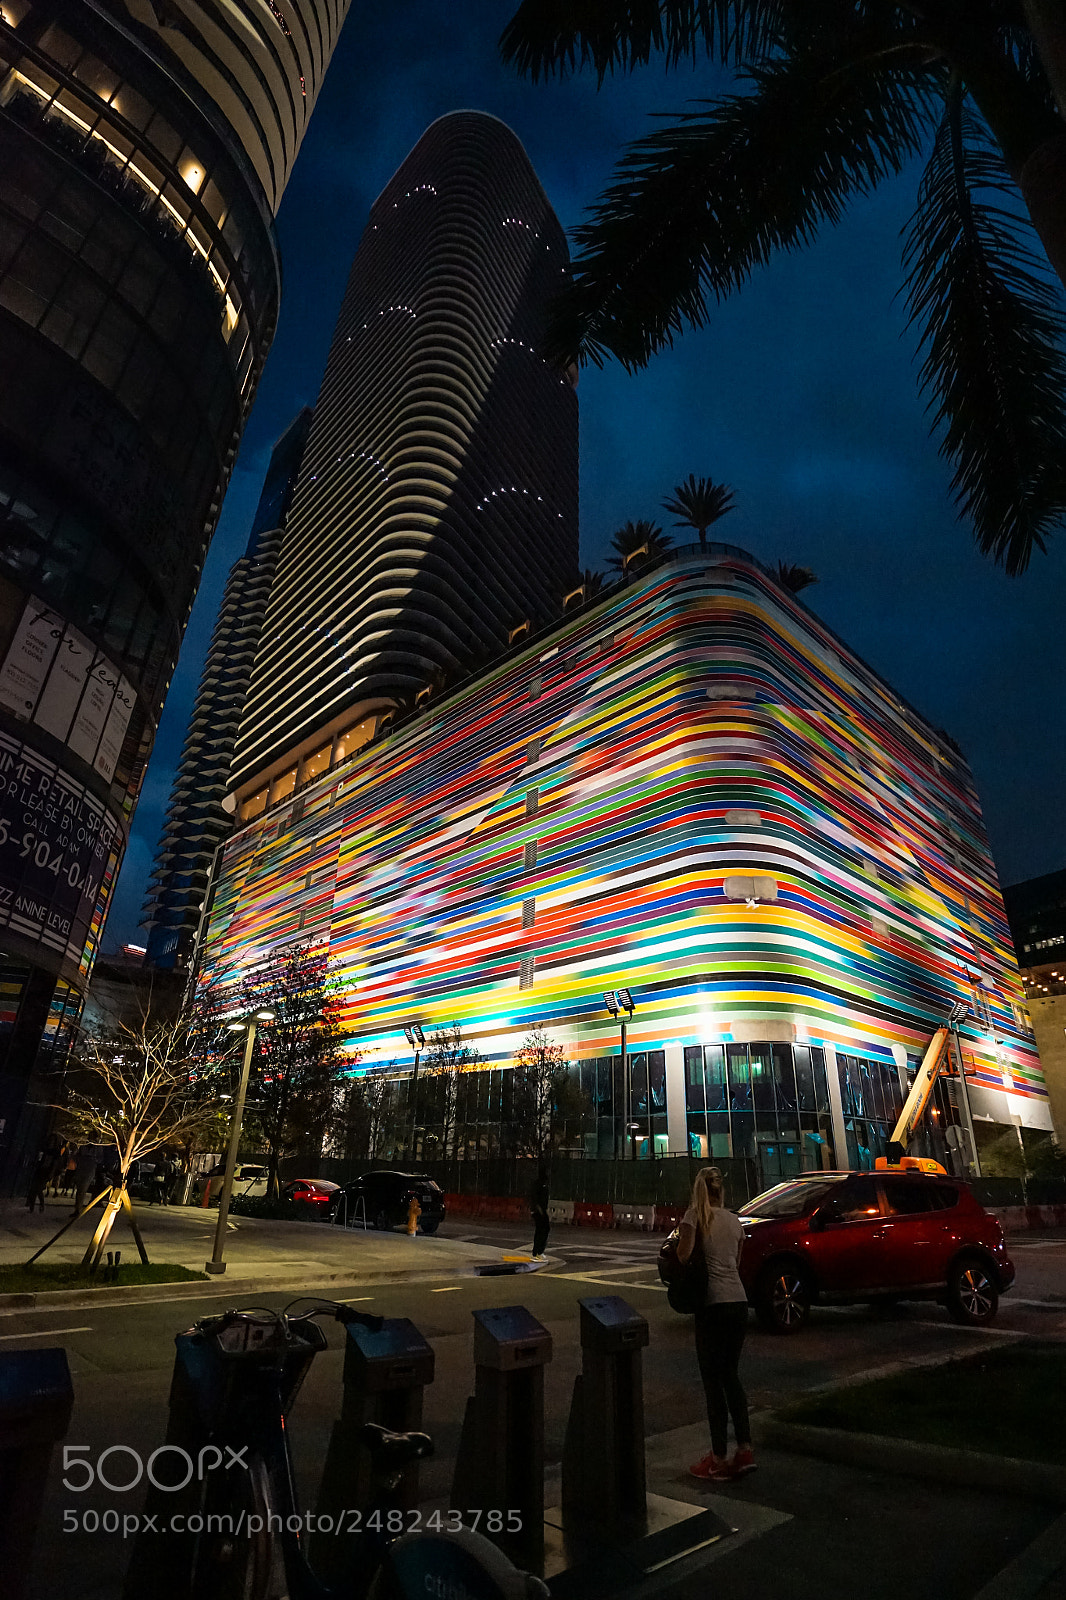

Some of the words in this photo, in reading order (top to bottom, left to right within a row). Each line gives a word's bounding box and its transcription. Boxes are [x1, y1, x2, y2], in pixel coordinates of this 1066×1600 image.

[29, 608, 82, 655] For
[86, 658, 132, 709] Lease
[20, 788, 60, 823] LEASE
[38, 776, 83, 822] RETAIL
[86, 812, 114, 850] SPACE
[23, 812, 49, 836] CALL
[47, 911, 71, 936] LEVEL
